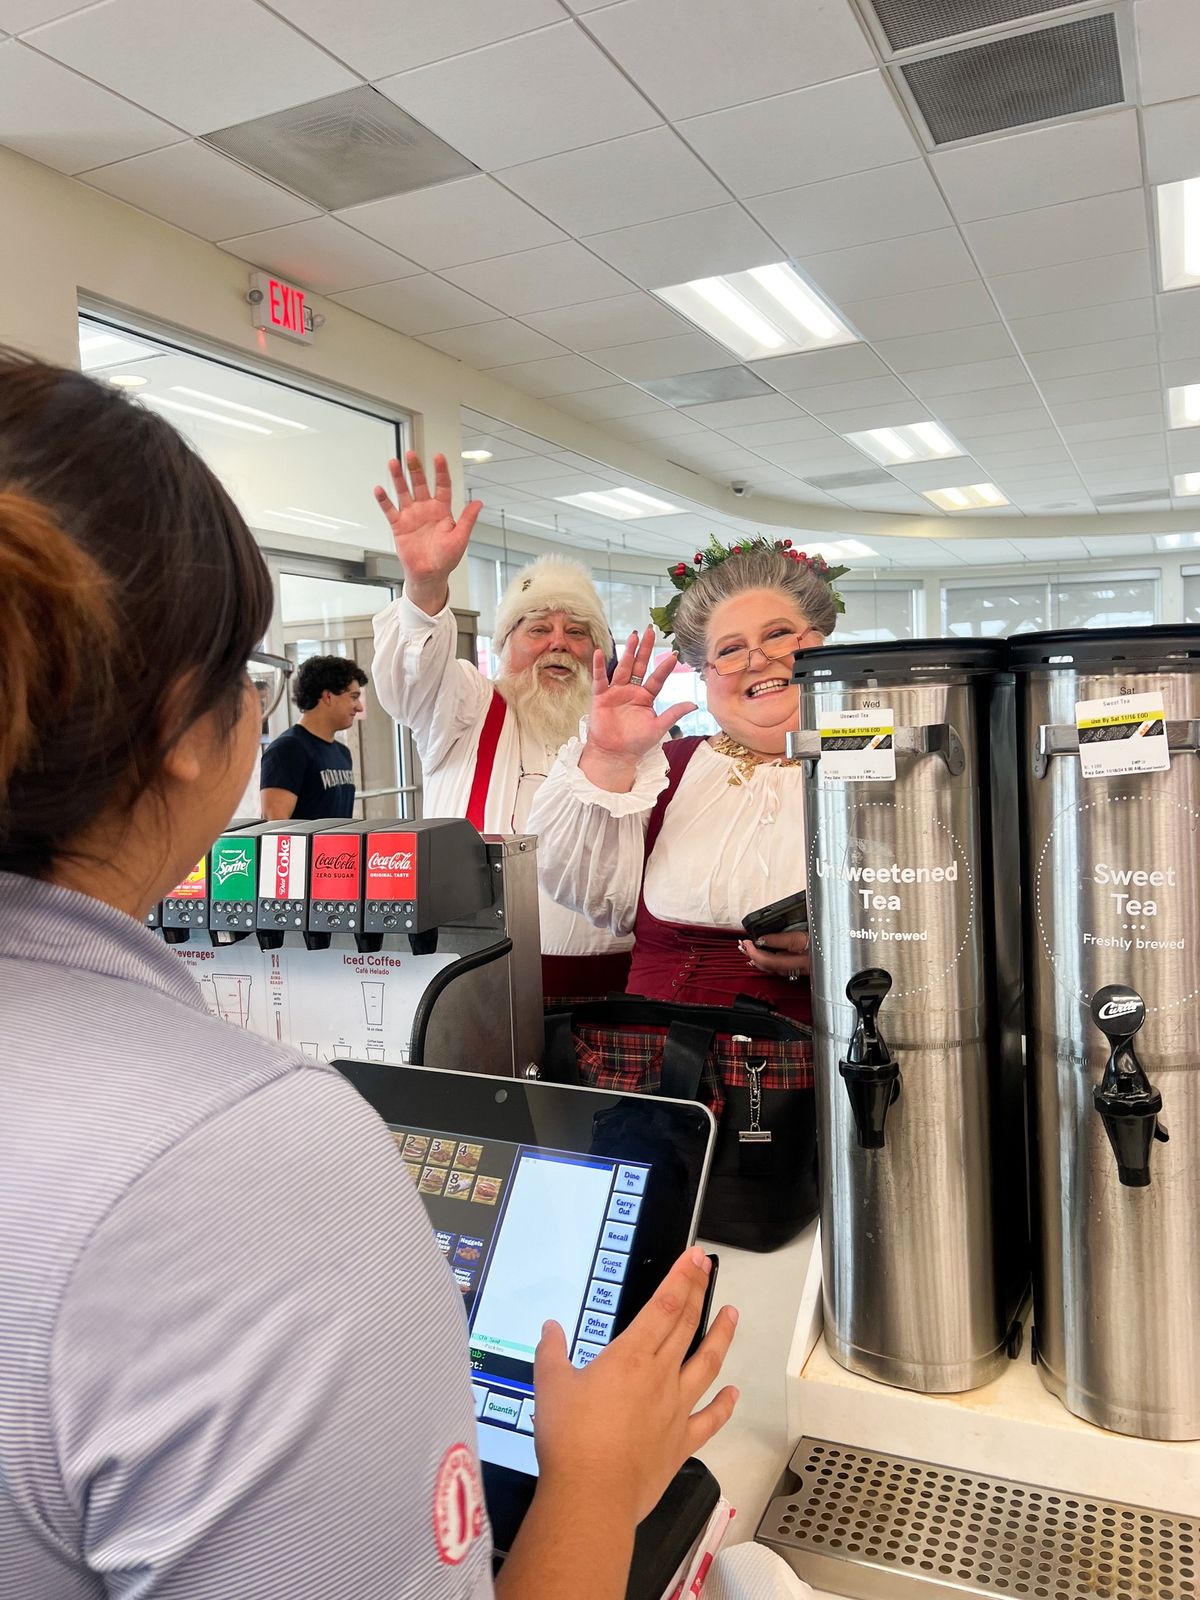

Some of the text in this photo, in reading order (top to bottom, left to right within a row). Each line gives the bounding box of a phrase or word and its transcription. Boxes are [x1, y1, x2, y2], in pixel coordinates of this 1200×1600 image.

[269, 279, 305, 334] EXIT
[1120, 686, 1135, 695] Sat
[862, 700, 881, 708] Wed
[277, 838, 291, 878] Coke
[314, 852, 357, 870] Coca-Cola
[368, 852, 412, 870] Coca-Cola
[219, 860, 246, 876] Sprite
[1093, 863, 1176, 886] Sweet
[858, 889, 901, 911] Tea
[1110, 893, 1158, 916] Tea
[881, 930, 928, 941] brewed
[1083, 933, 1185, 951] Freshly brewed
[343, 954, 401, 967] Iced Coffee
[369, 968, 390, 976] Helado
[1098, 1001, 1137, 1020] Curtis
[405, 1136, 416, 1147] 2
[431, 1141, 442, 1152] 3
[458, 1145, 468, 1156] 4
[424, 1168, 433, 1178] 7
[450, 1173, 460, 1184] 8
[624, 1171, 640, 1181] Dine
[616, 1199, 636, 1209] Carry-
[618, 1207, 630, 1215] Out
[460, 1237, 484, 1247] Nuggets
[608, 1231, 628, 1242] Recall
[601, 1257, 622, 1268] Guest
[602, 1264, 617, 1274] Info
[596, 1287, 613, 1298] Mgr.
[592, 1295, 613, 1306] Funct.
[587, 1317, 609, 1329] Other
[584, 1325, 607, 1337] Funct.
[469, 1361, 483, 1370] ot:
[488, 1402, 517, 1417] Quantity
